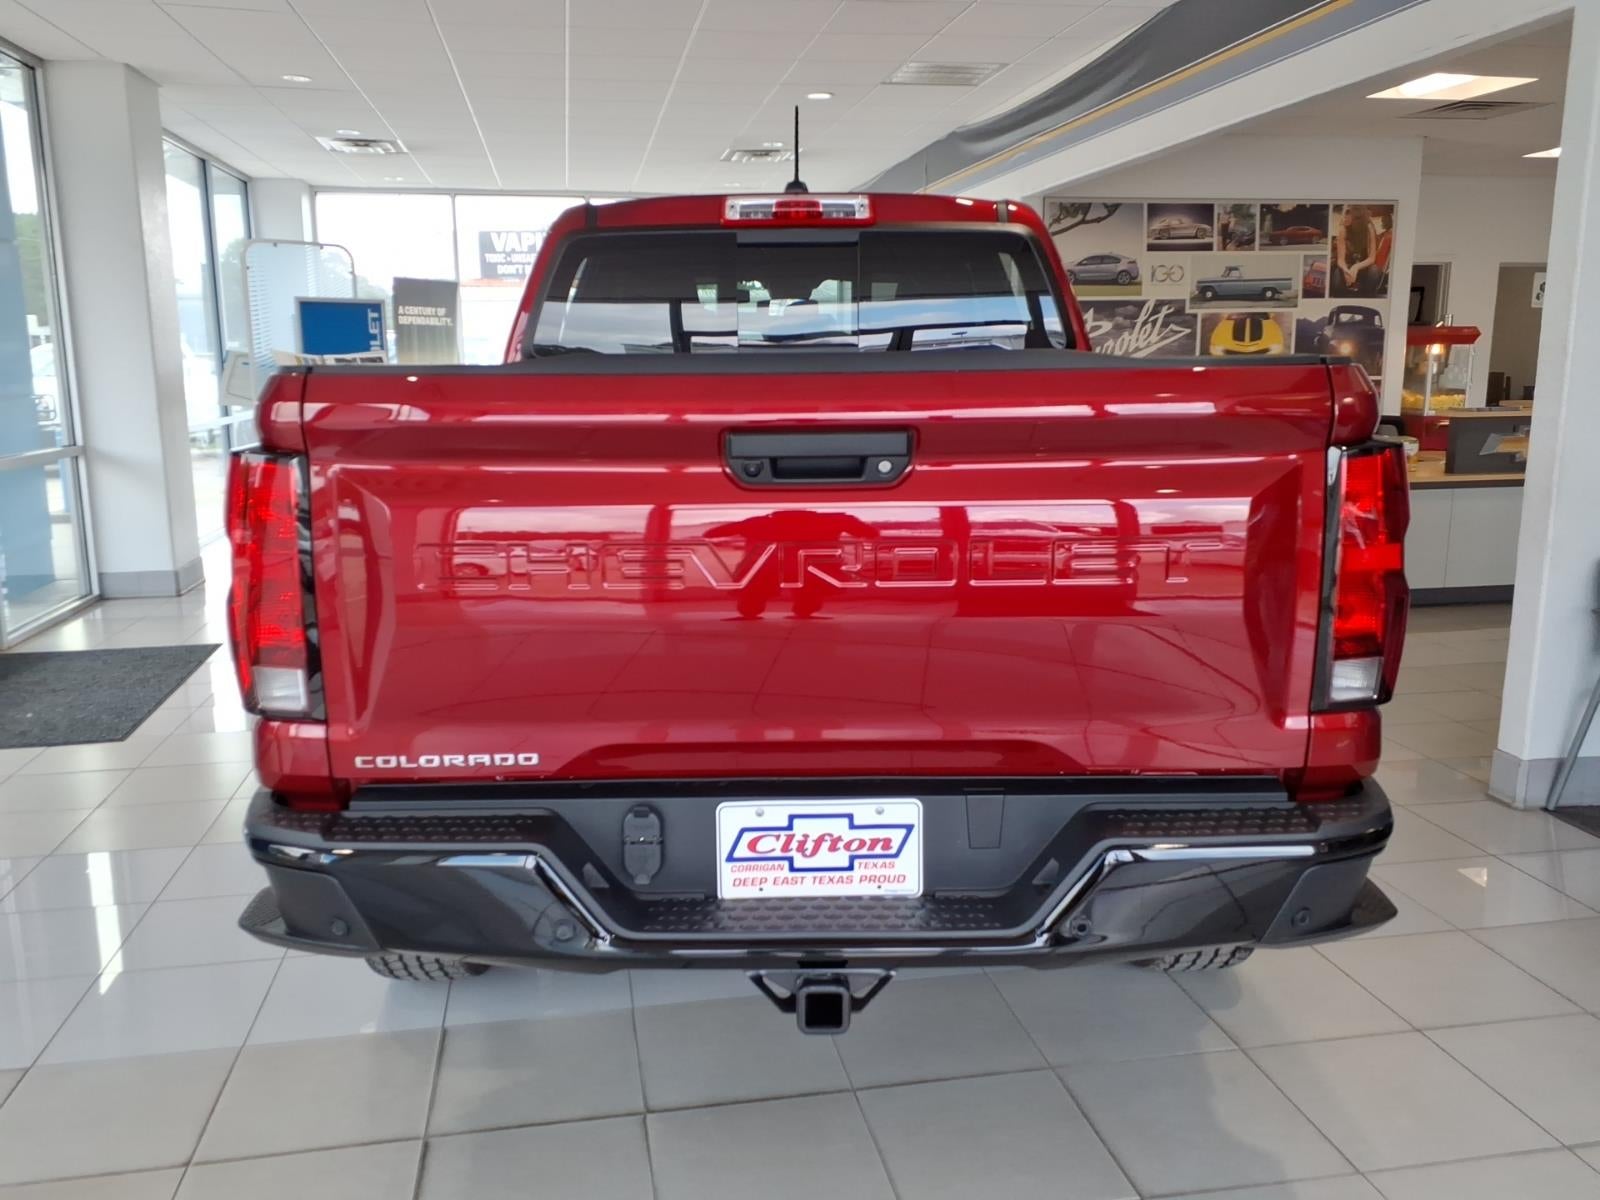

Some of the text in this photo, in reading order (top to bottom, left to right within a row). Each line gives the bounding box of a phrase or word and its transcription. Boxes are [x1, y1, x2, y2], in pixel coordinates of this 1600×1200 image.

[413, 536, 1224, 590] CHEVROLET
[354, 753, 540, 768] COLORADO
[747, 833, 893, 858] Clifton
[730, 861, 896, 873] CORRIGAN TEXAS
[732, 874, 907, 888] DEEP EAST TEXAS PROUD
